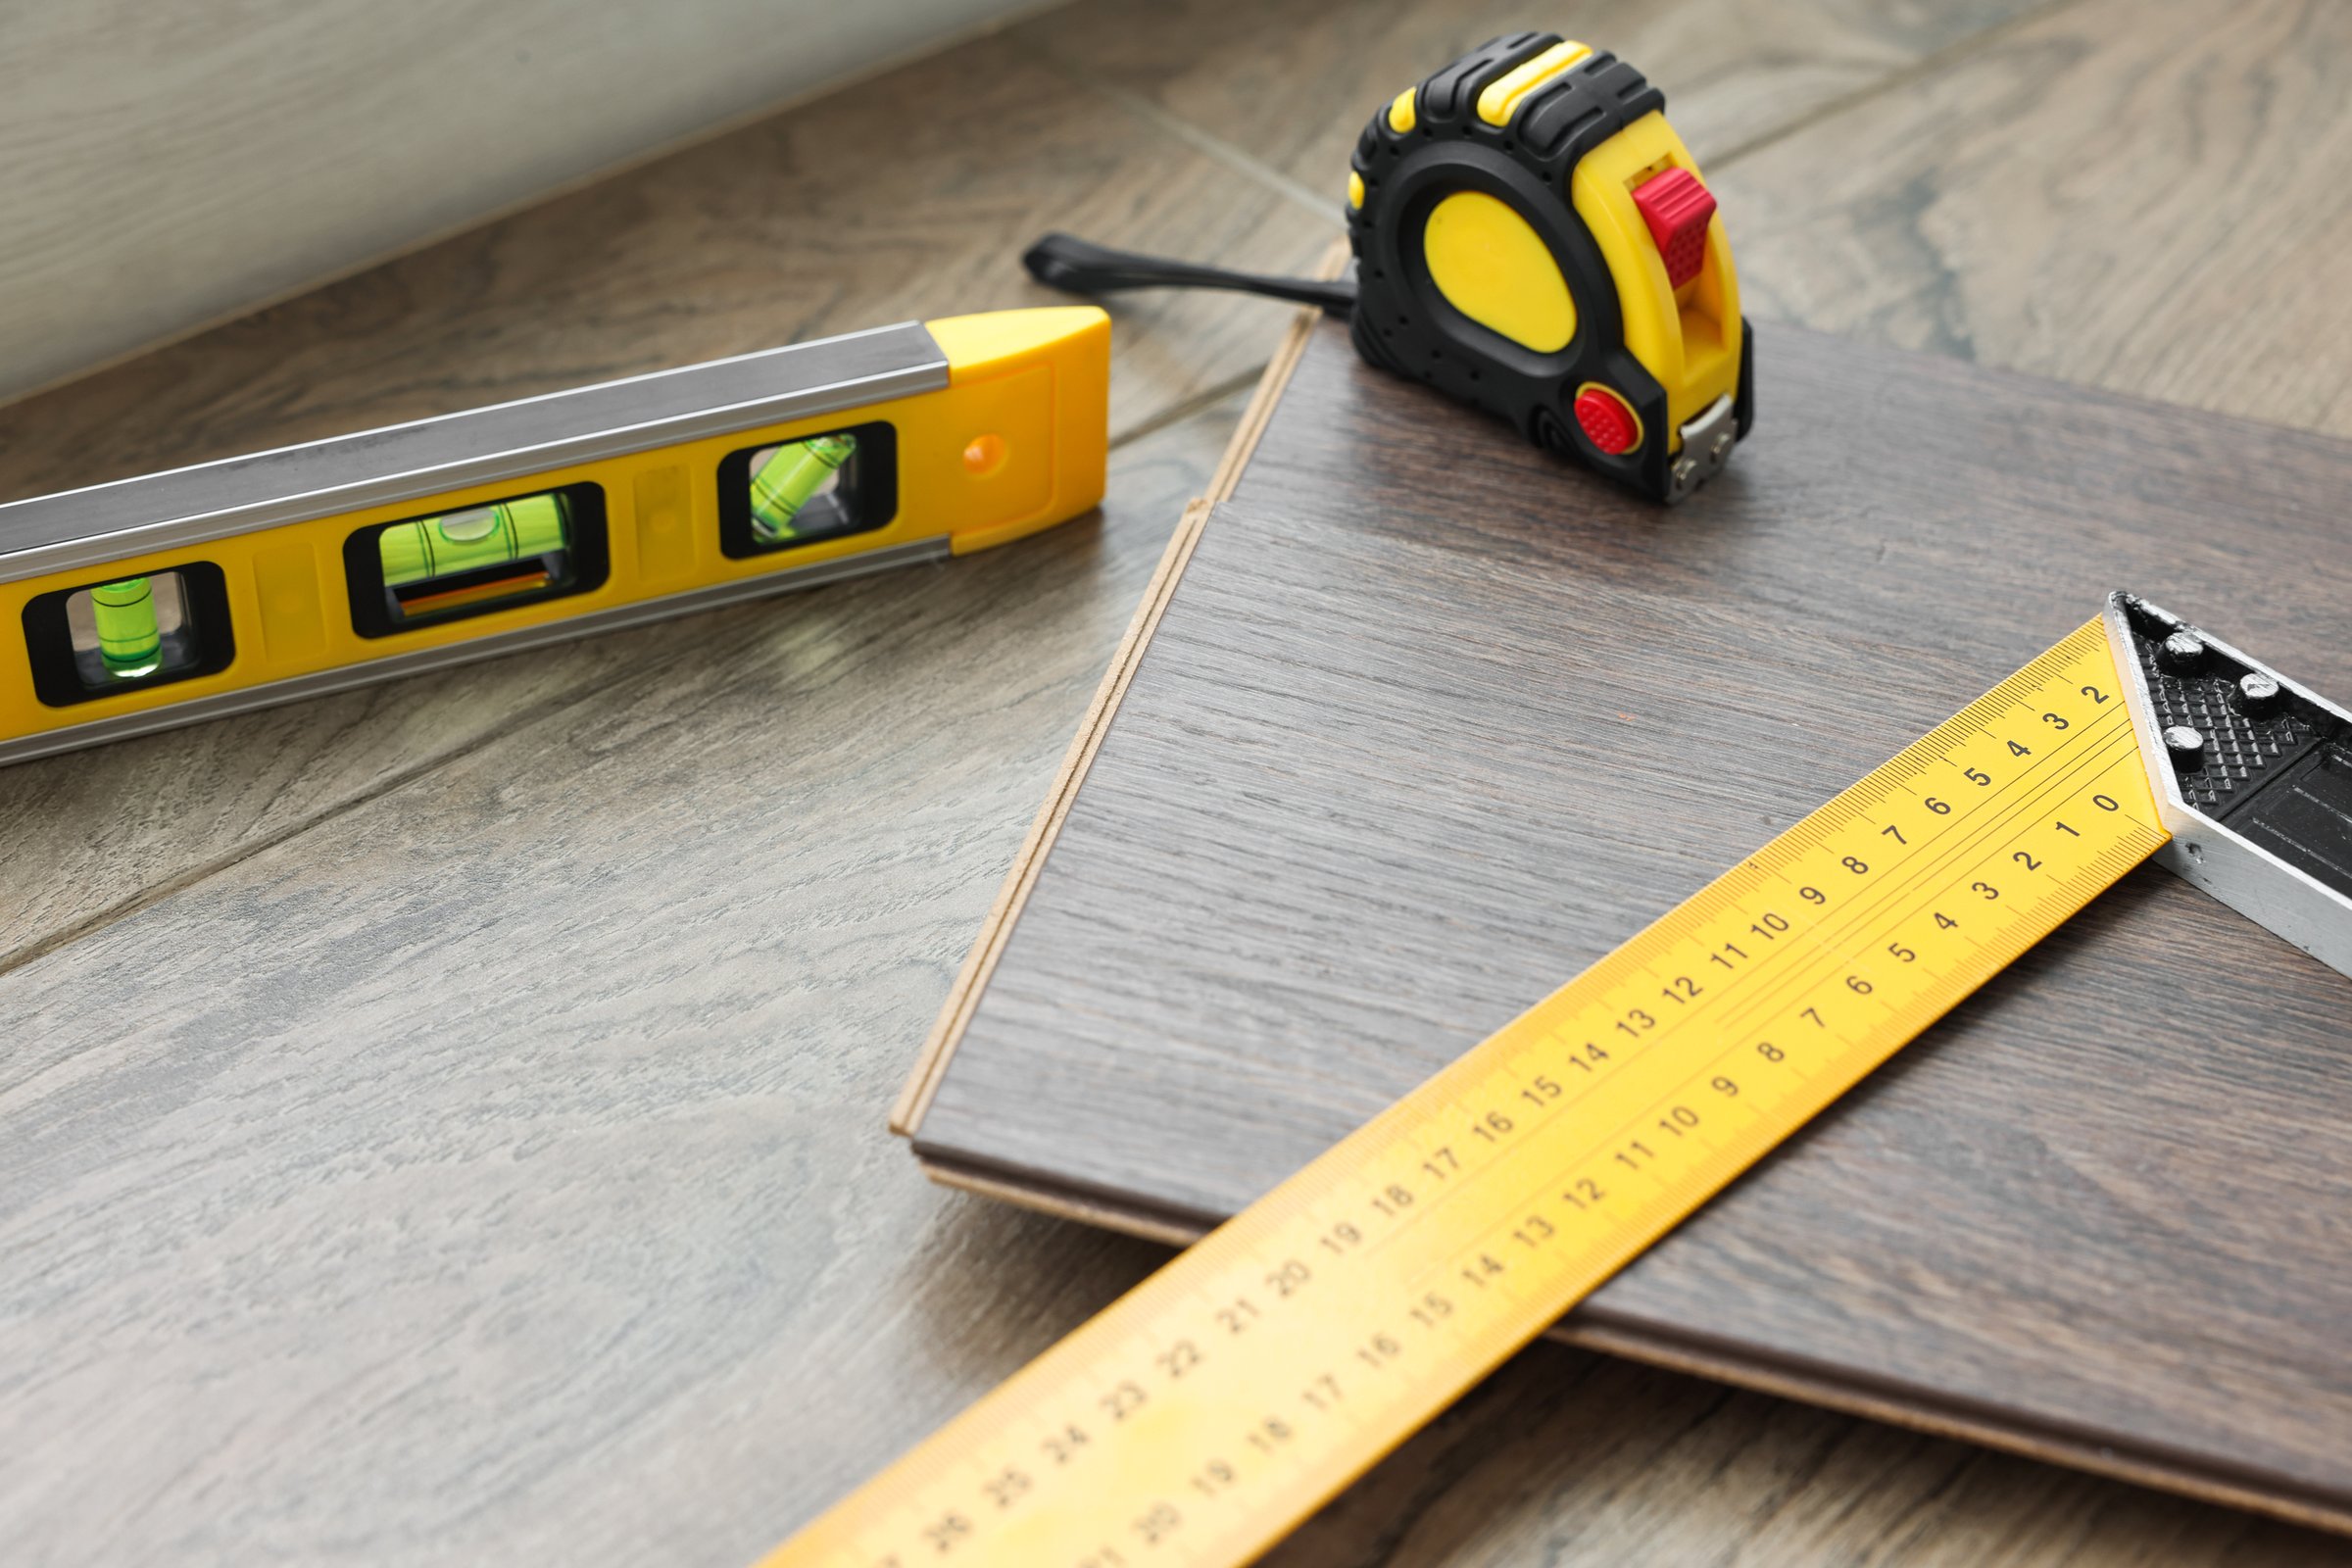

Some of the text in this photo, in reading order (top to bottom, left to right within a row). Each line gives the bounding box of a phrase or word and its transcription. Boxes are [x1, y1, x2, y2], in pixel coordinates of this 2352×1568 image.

[1043, 1423, 1091, 1466] 24
[1099, 1379, 1149, 1424] 23
[1155, 1339, 1203, 1381] 22
[1214, 1296, 1261, 1337] 21
[1264, 1257, 1313, 1300] 20
[1318, 1221, 1363, 1255] 19
[1370, 1182, 1416, 1217] 18
[1420, 1144, 1460, 1181] 17
[1472, 1111, 1514, 1143] 16
[1520, 1075, 1563, 1107] 15
[1569, 1042, 1609, 1072] 14
[1616, 1008, 1656, 1038] 13
[1662, 976, 1704, 1004] 12
[1710, 942, 1748, 969] 11
[1750, 912, 1789, 941] 10
[1798, 886, 1827, 906] 9
[1840, 856, 1869, 875] 8
[1881, 824, 1907, 846] 7
[1924, 797, 1951, 815] 6
[1963, 766, 1991, 787] 5
[2006, 740, 2033, 758] 4
[2041, 712, 2070, 731] 3
[2081, 685, 2110, 705] 2
[1300, 1371, 1343, 1410] 17
[1355, 1332, 1402, 1368] 16
[1408, 1290, 1455, 1328] 15
[1460, 1252, 1506, 1288] 14
[1511, 1212, 1557, 1249] 13
[1561, 1176, 1607, 1210] 12
[1614, 1140, 1654, 1170] 11
[1658, 1105, 1700, 1137] 10
[1710, 1076, 1740, 1098] 9
[1756, 1042, 1786, 1063] 8
[1799, 1006, 1826, 1028] 7
[1845, 975, 1874, 995] 6
[1887, 942, 1916, 963] 5
[1934, 911, 1959, 930] 4
[1971, 881, 1999, 901] 3
[2012, 851, 2043, 871] 2
[2055, 820, 2081, 838] 1
[2092, 794, 2120, 812] 0
